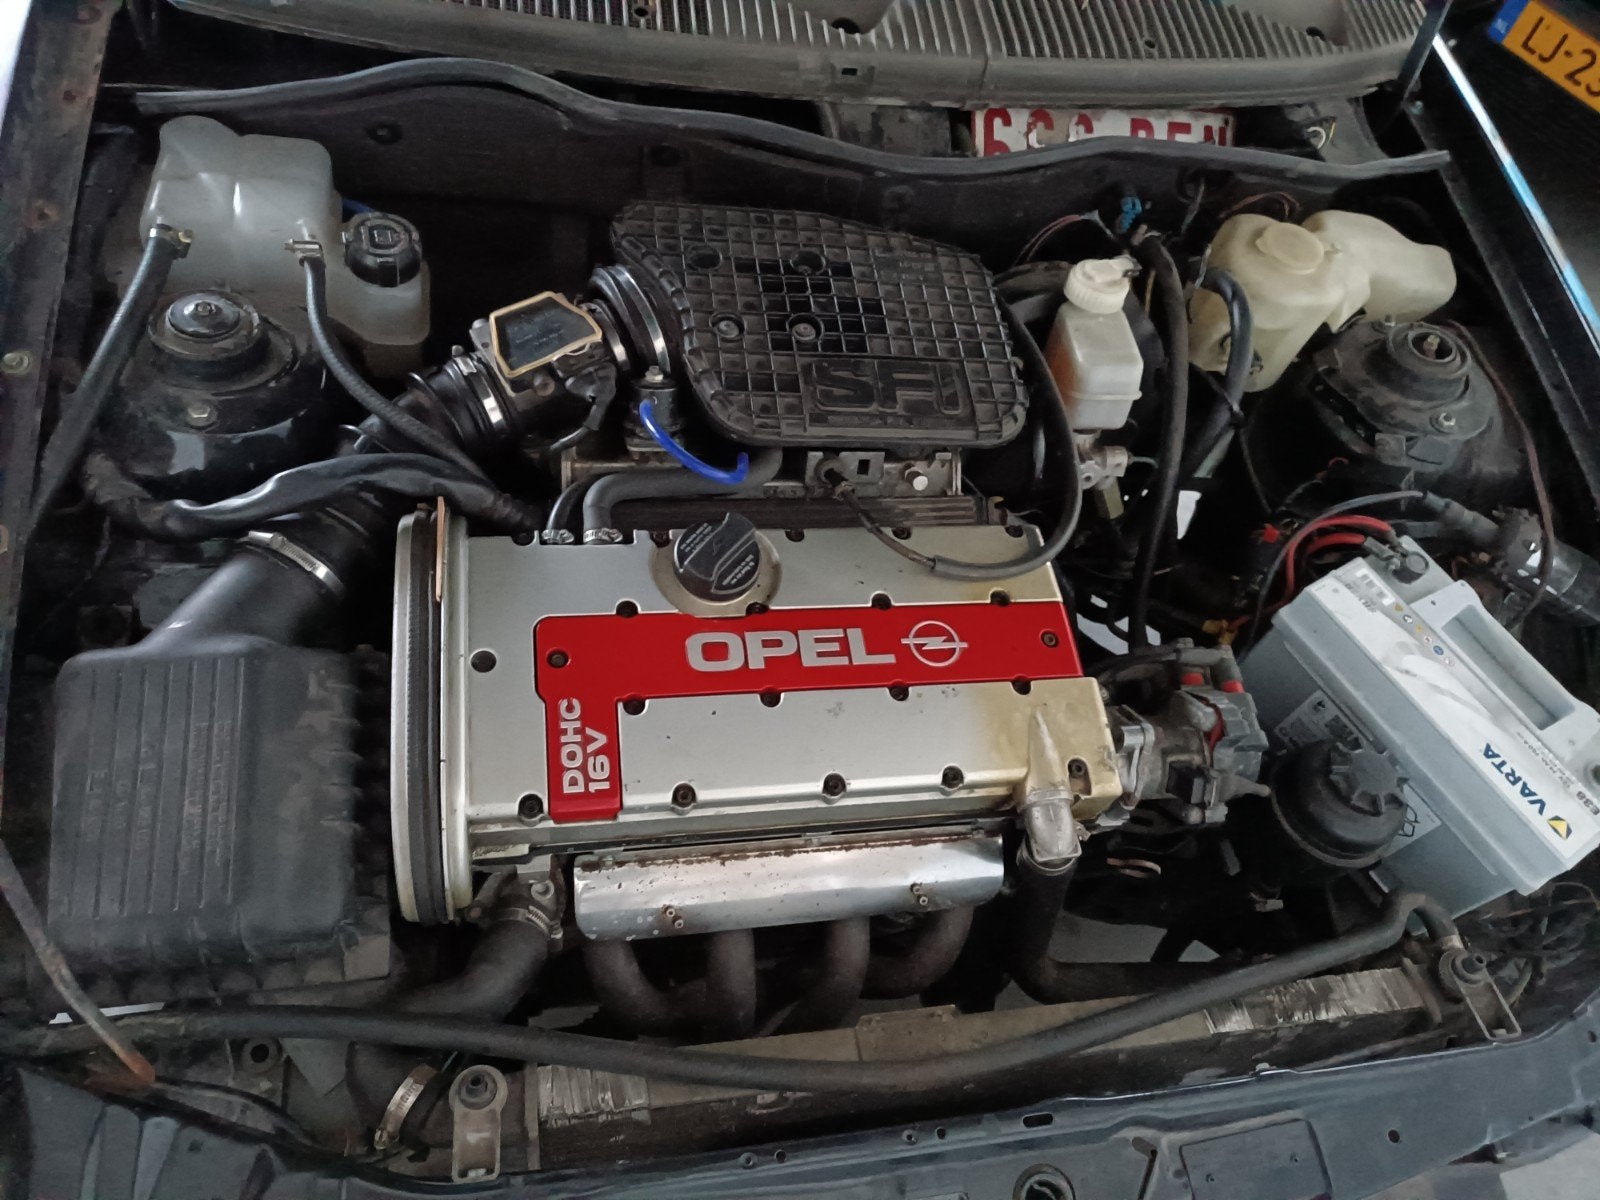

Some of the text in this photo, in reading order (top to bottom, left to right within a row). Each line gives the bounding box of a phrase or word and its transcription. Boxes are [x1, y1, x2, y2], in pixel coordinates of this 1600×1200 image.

[685, 627, 896, 672] OPEL
[558, 698, 585, 794] DOHC
[585, 726, 610, 793] 16V
[1483, 742, 1547, 816] VARTA
